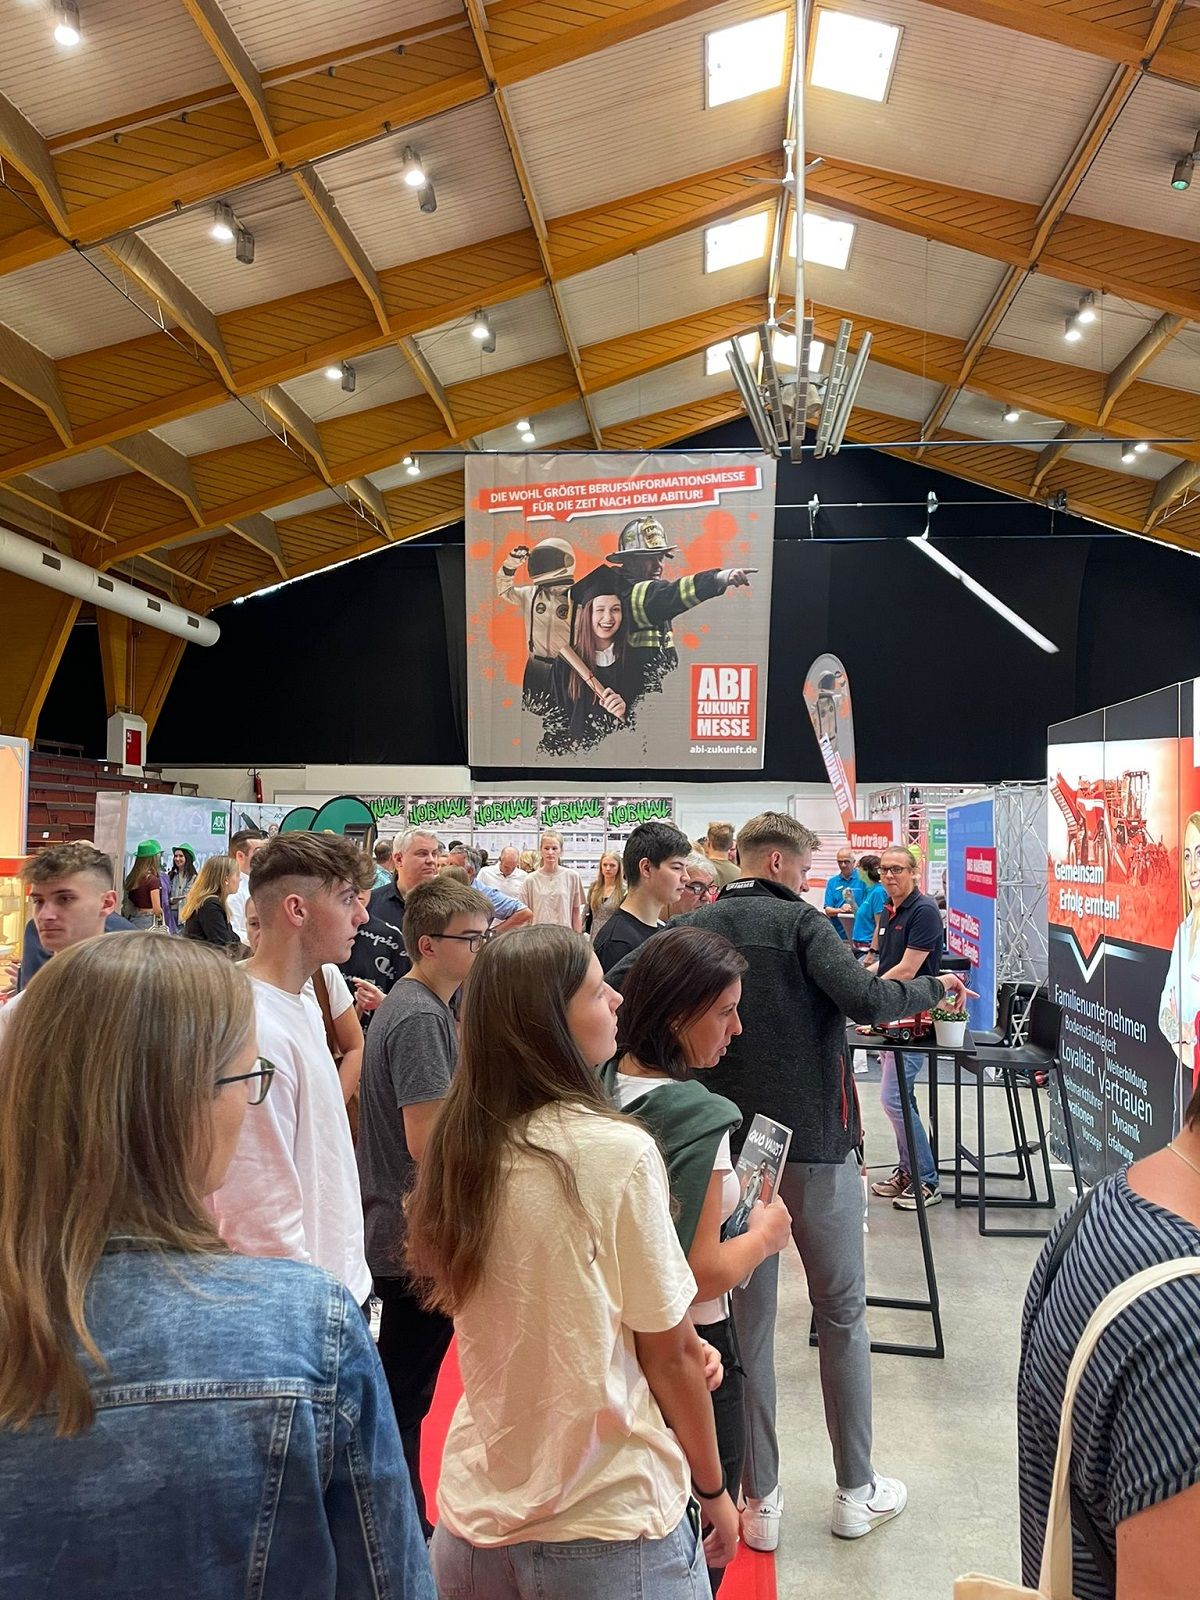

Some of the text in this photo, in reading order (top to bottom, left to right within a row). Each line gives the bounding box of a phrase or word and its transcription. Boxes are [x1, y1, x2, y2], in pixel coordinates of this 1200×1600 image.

[490, 492, 507, 503] DIE
[509, 489, 542, 501] WOHL
[588, 471, 745, 494] BERUFSINFORMATIONSMESSE
[532, 489, 704, 512] FÜR DIE ZEIT NACH DEM ABITUR!
[697, 667, 752, 700] ABI
[697, 701, 750, 715] ZUKUNFT
[697, 718, 751, 737] MESSE
[689, 745, 758, 754] abi-zukunft.de
[408, 796, 470, 826] JOBWALL
[474, 797, 537, 827] JOBWALL
[540, 797, 604, 827] JOBWALL
[608, 798, 671, 828] JOBWALL
[851, 833, 889, 849] Vorträge
[1055, 859, 1104, 884] Gemeinsam
[1060, 888, 1120, 920] Erfolg ernten!
[1055, 983, 1146, 1043] Familienunternehmen
[1065, 1014, 1117, 1055] Bodenständigkeit
[1062, 1039, 1095, 1077] Loyalität
[1106, 1056, 1148, 1096] Weiterbildung
[1098, 1066, 1153, 1126] Vertrauen
[748, 1129, 766, 1147] QUO
[1082, 1125, 1103, 1152] Vorsorge
[1112, 1109, 1140, 1143] Dynamik
[1107, 1132, 1134, 1163] Erfahrung
